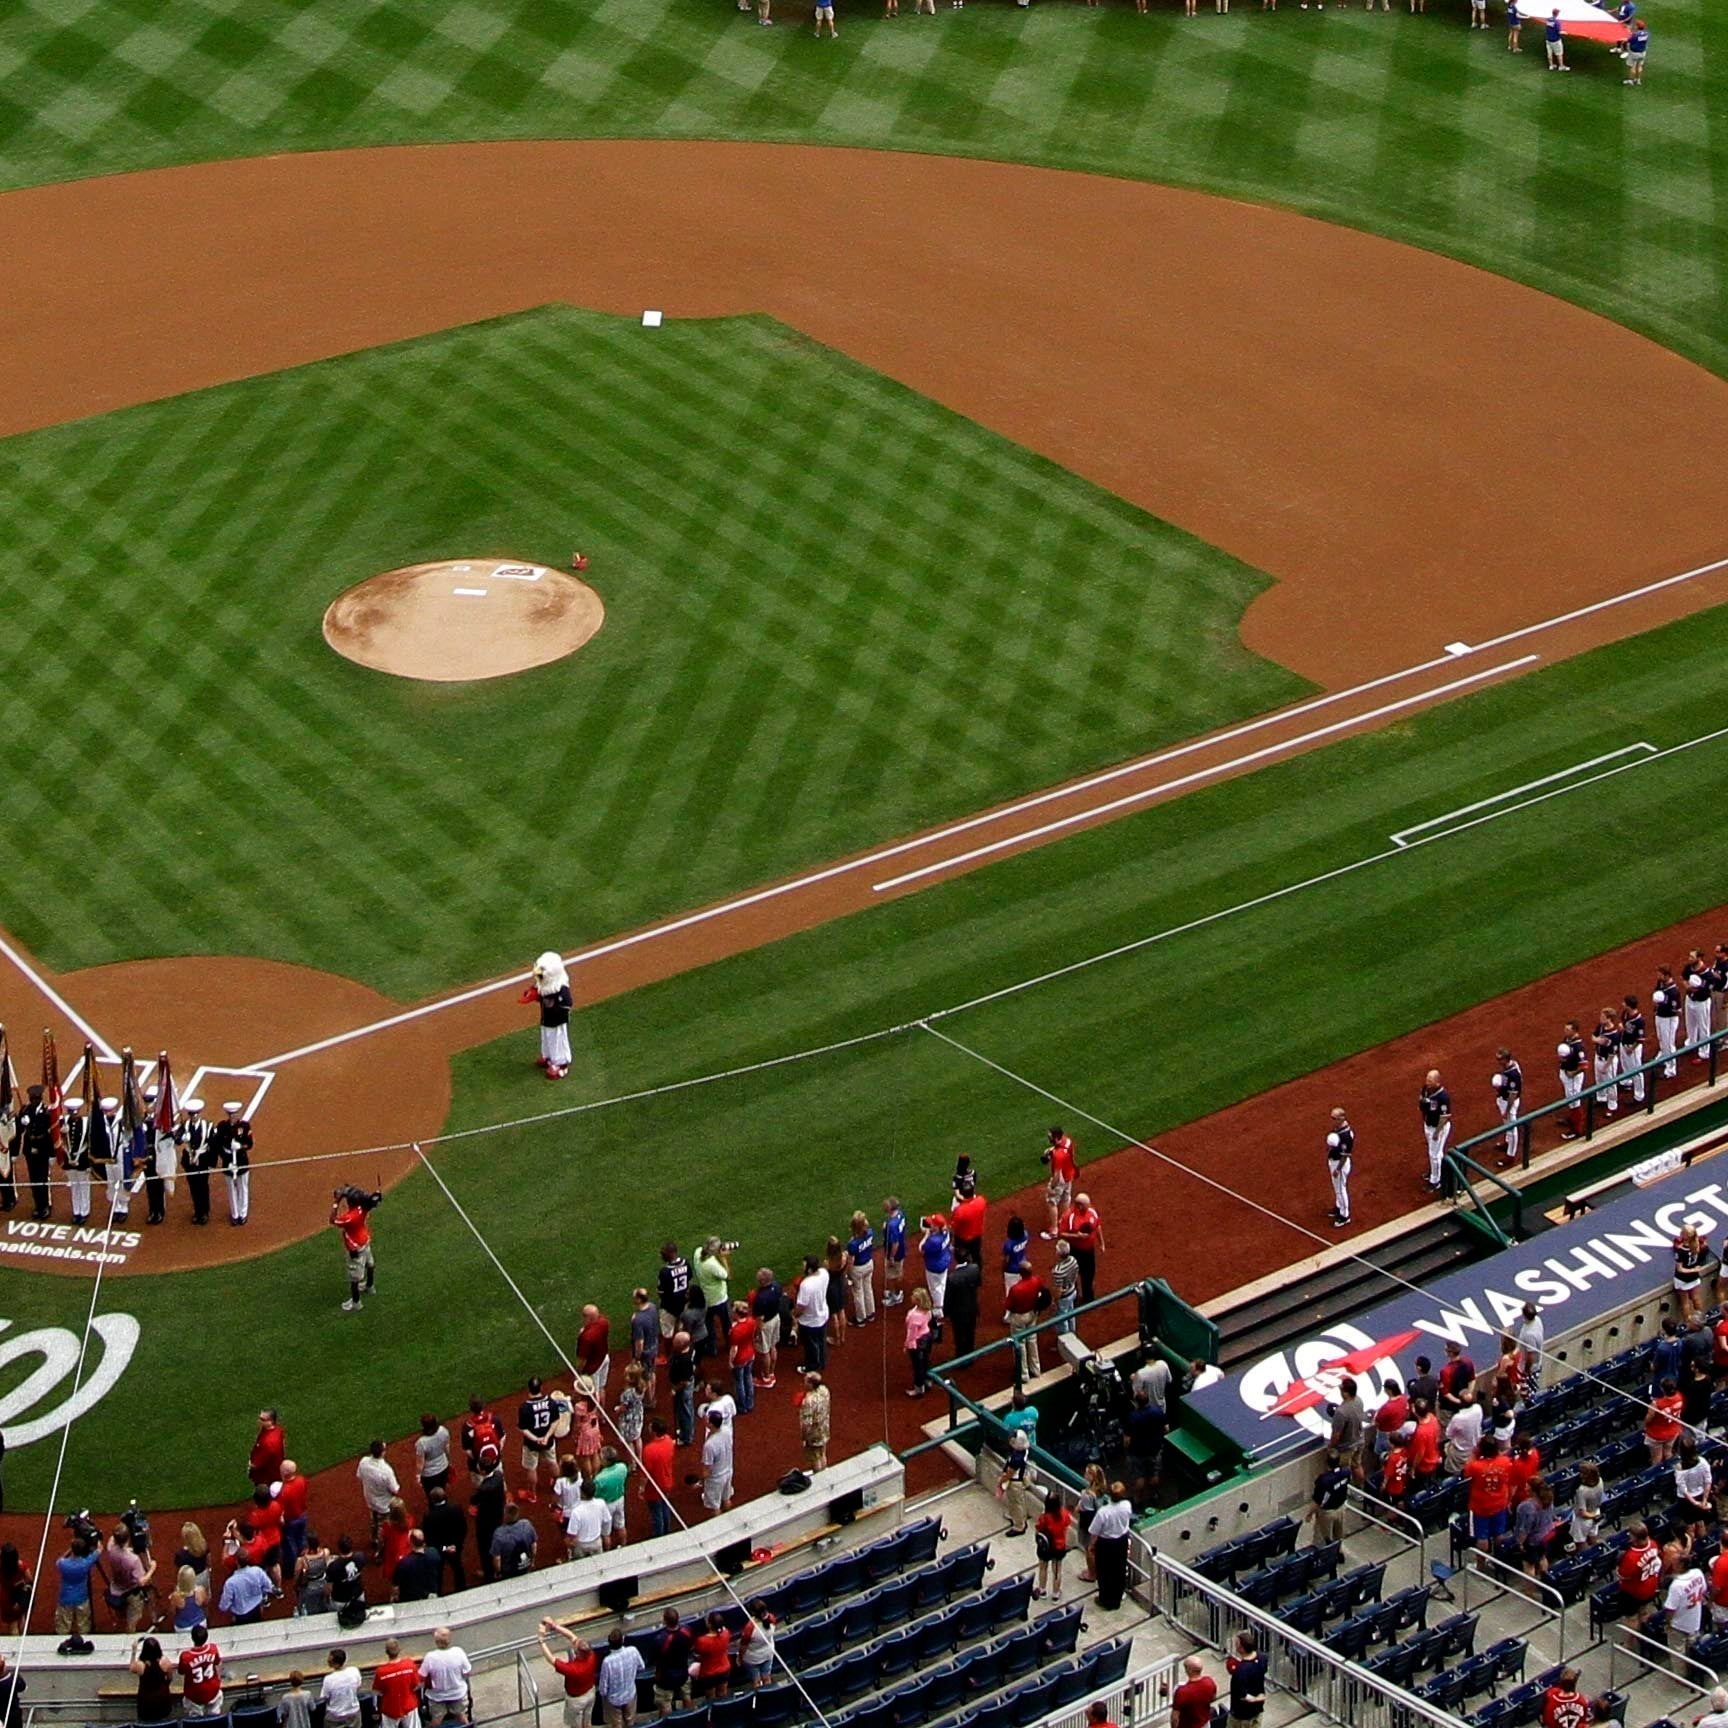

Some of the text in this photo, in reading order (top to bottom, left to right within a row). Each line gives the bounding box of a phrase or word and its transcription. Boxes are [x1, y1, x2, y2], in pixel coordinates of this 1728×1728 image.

[7, 1220, 142, 1248] VOTE NATS
[673, 1276, 688, 1293] 13
[534, 1411, 550, 1428] 13
